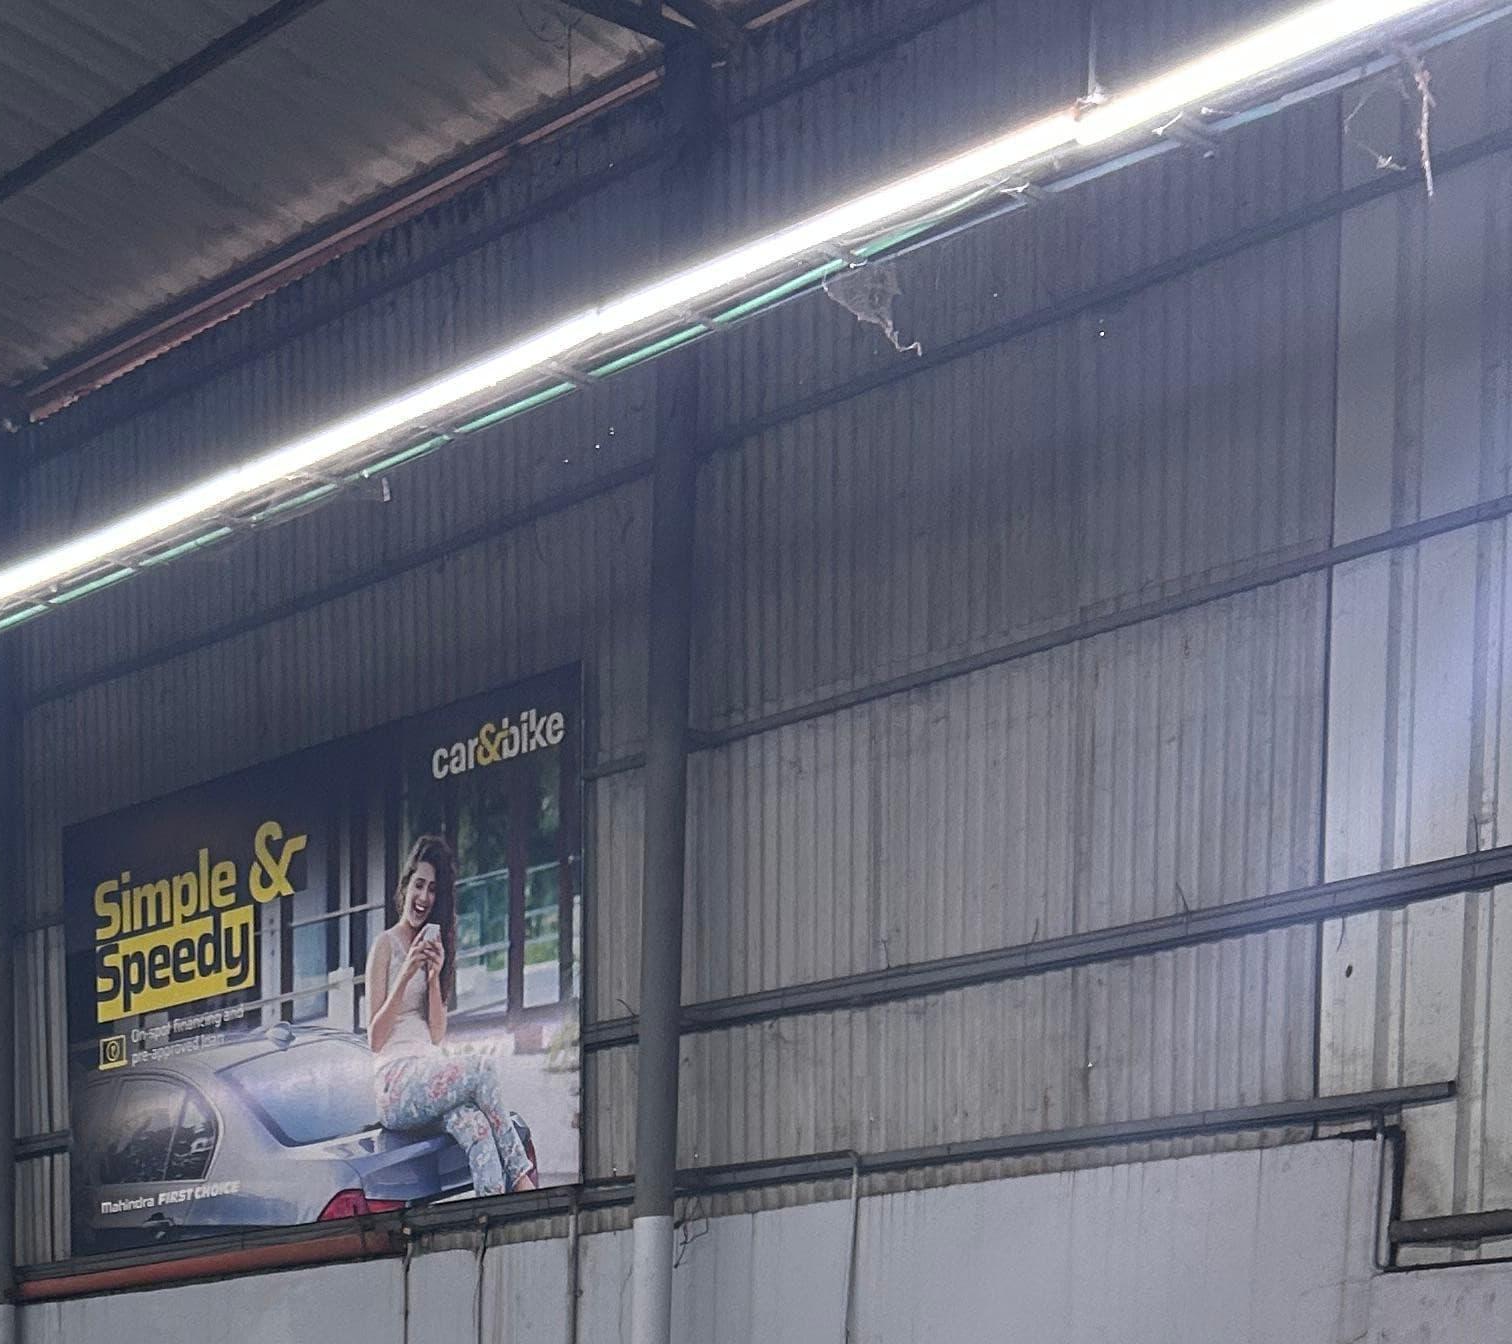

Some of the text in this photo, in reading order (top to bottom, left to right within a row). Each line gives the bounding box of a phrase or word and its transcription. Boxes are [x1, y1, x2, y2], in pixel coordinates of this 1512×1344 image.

[432, 708, 565, 780] car&bike
[94, 820, 308, 941] Simple &
[96, 917, 252, 1013] Speedy
[131, 1003, 244, 1043] On-spot financing and
[101, 1180, 241, 1214] Mahindra FIRST CHOICE
